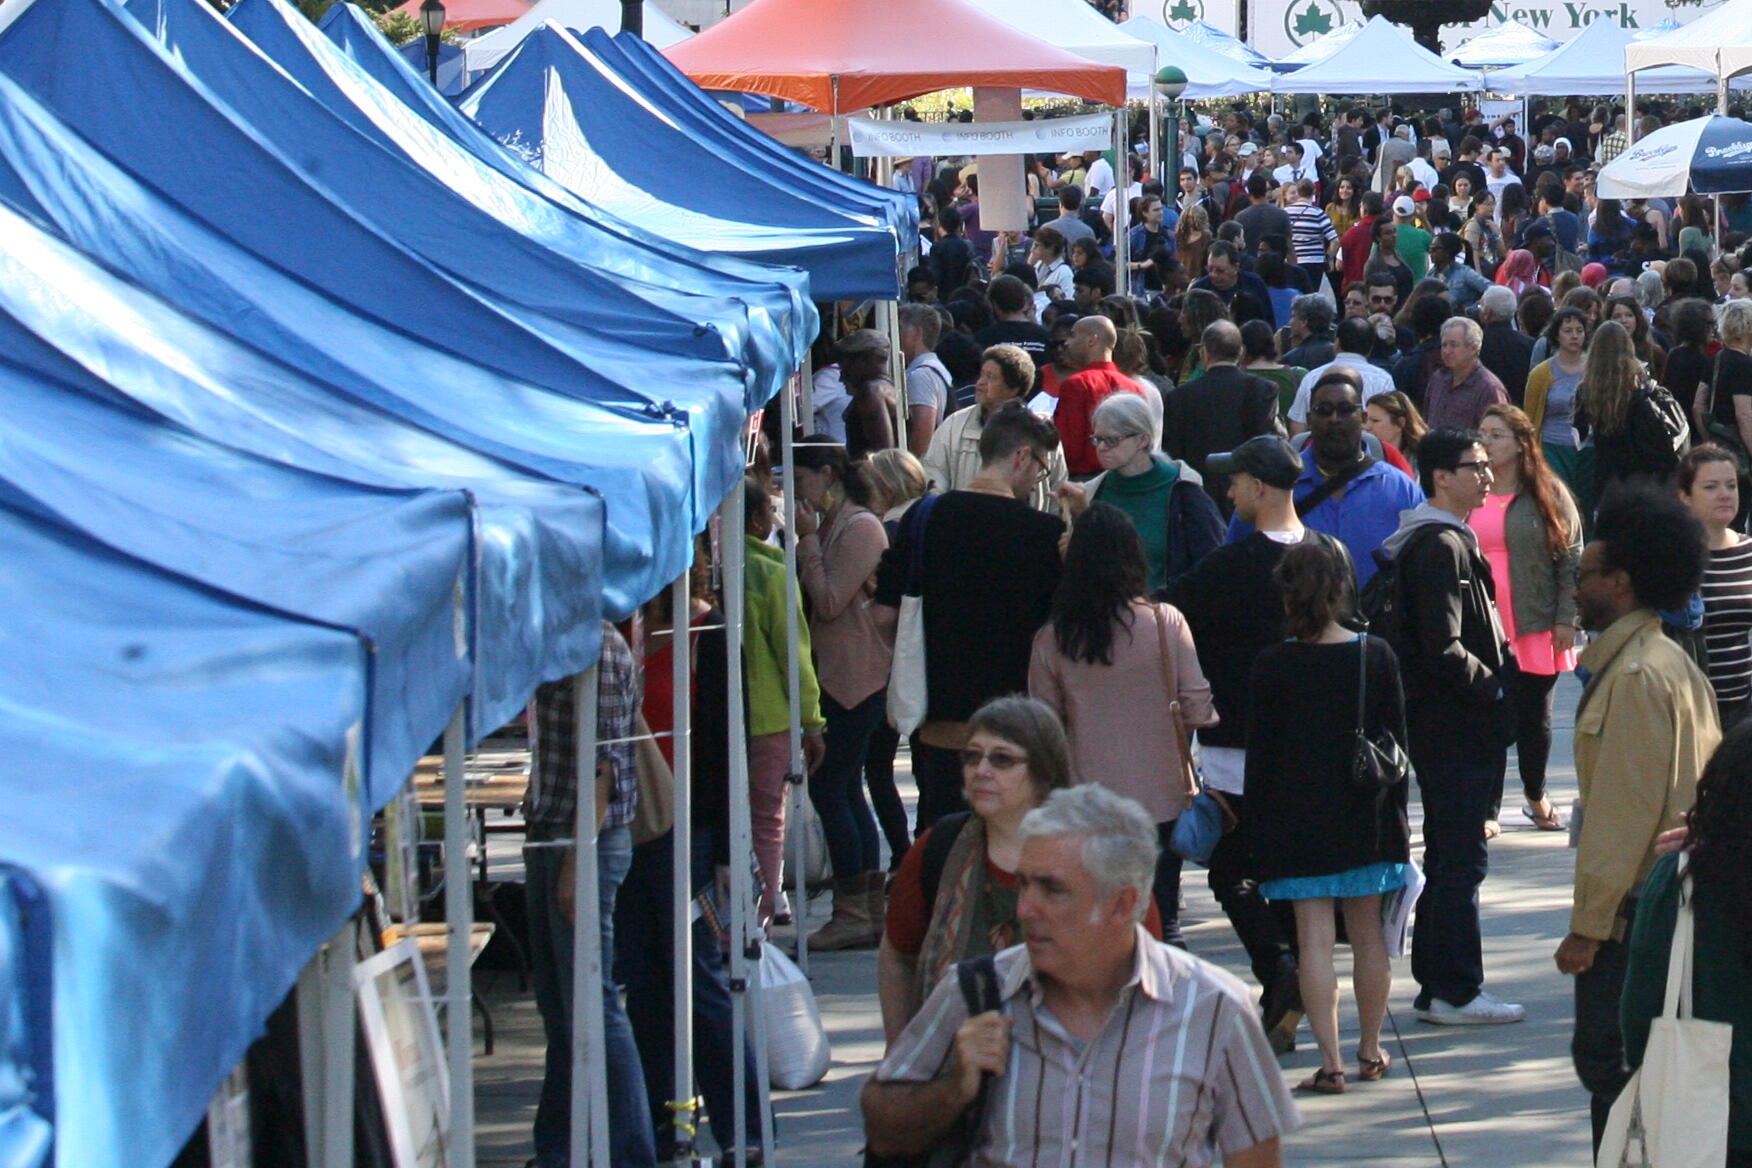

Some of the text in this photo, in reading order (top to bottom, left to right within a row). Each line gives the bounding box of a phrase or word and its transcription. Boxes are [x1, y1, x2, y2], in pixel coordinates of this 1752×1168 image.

[1485, 2, 1553, 28] New
[889, 132, 921, 142] BOOTH
[980, 130, 1014, 141] BOOTH
[1051, 126, 1109, 137] INFO BOOTH
